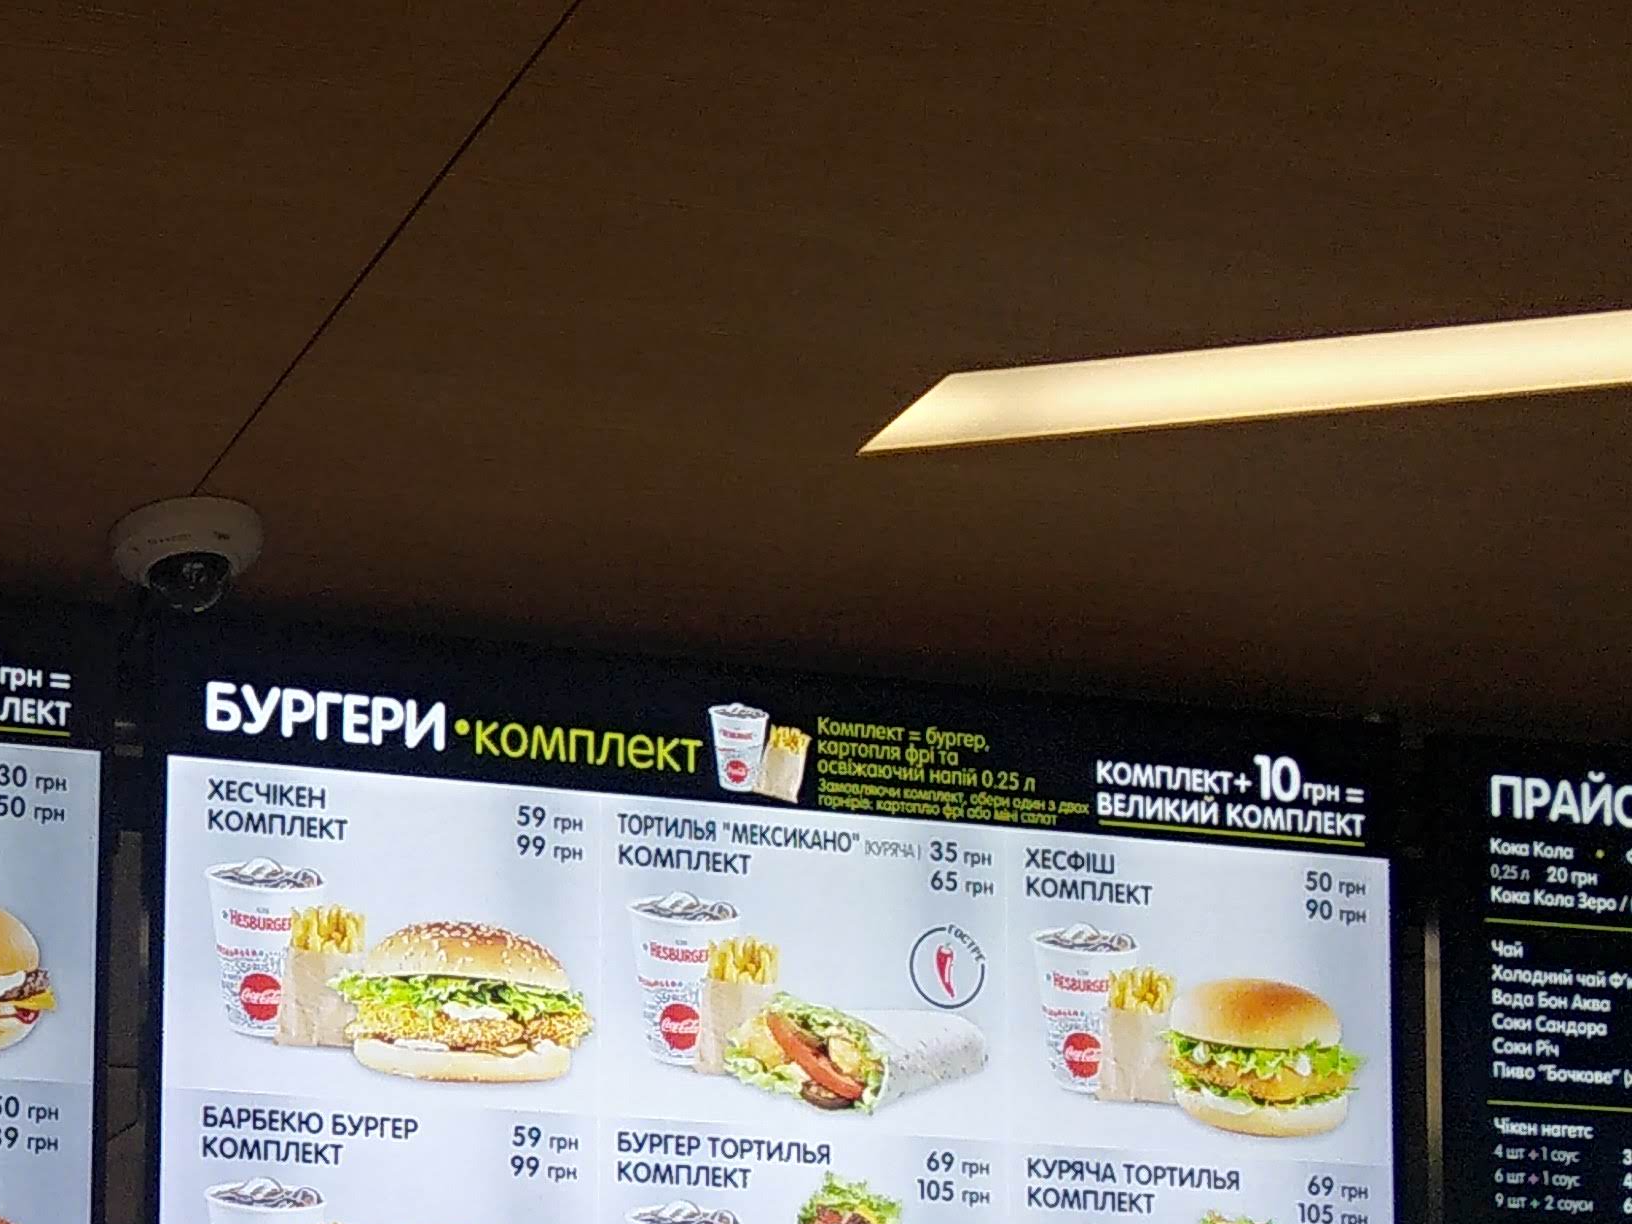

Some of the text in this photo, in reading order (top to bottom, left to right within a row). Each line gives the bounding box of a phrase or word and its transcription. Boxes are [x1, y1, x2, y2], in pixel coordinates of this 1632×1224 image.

[0, 666, 42, 690] грн
[205, 681, 704, 773] БУРГЕРИ комплект
[35, 775, 67, 795] грн
[208, 779, 326, 810] ХЕСЧІКЕН
[33, 805, 65, 825] грн
[207, 808, 348, 840] КОМПЛЕКТ
[517, 806, 583, 833] 59 грн
[1097, 792, 1366, 838] ВЕЛИКИЙ КОМПЛЕКТ
[618, 813, 861, 854] ТОРТИЛЬЯ "МЕКСИКАНО"
[517, 835, 583, 863] 99 грн
[618, 844, 752, 875] КОМПЛЕКТ
[929, 840, 992, 869] 35 грн
[1025, 847, 1115, 875] ХЕСФІШ
[1490, 837, 1574, 859] Кока Кола
[930, 870, 993, 898] 65 грн
[1025, 876, 1153, 907] КОМПЛЕКТ
[1305, 872, 1366, 897] 50 грн
[1305, 900, 1366, 926] 90 грн
[947, 924, 986, 963] ГОСТРЕ
[1491, 940, 1523, 959] Чай
[1492, 989, 1611, 1012] Вода Бон Аква
[27, 1104, 59, 1124] грн
[202, 1105, 418, 1142] БАРБЕКЮ БУРГЕР
[26, 1135, 58, 1155] грн
[201, 1135, 344, 1166] КОМПЛЕКТ
[511, 1125, 579, 1152] 59 грн
[617, 1131, 831, 1166] БУРГЕР ТОРТИЛЬЯ
[510, 1156, 578, 1183] 99 грн
[616, 1161, 751, 1189] КОМПЛЕКТ
[926, 1151, 990, 1177] 69 грн
[1027, 1157, 1240, 1192] КУРЯЧА ТОРТИЛЬЯ
[917, 1178, 991, 1207] 105 грн
[1027, 1187, 1155, 1215] КОМПЛЕКТ
[1308, 1176, 1368, 1202] 69 грн
[1298, 1203, 1334, 1224] 105
